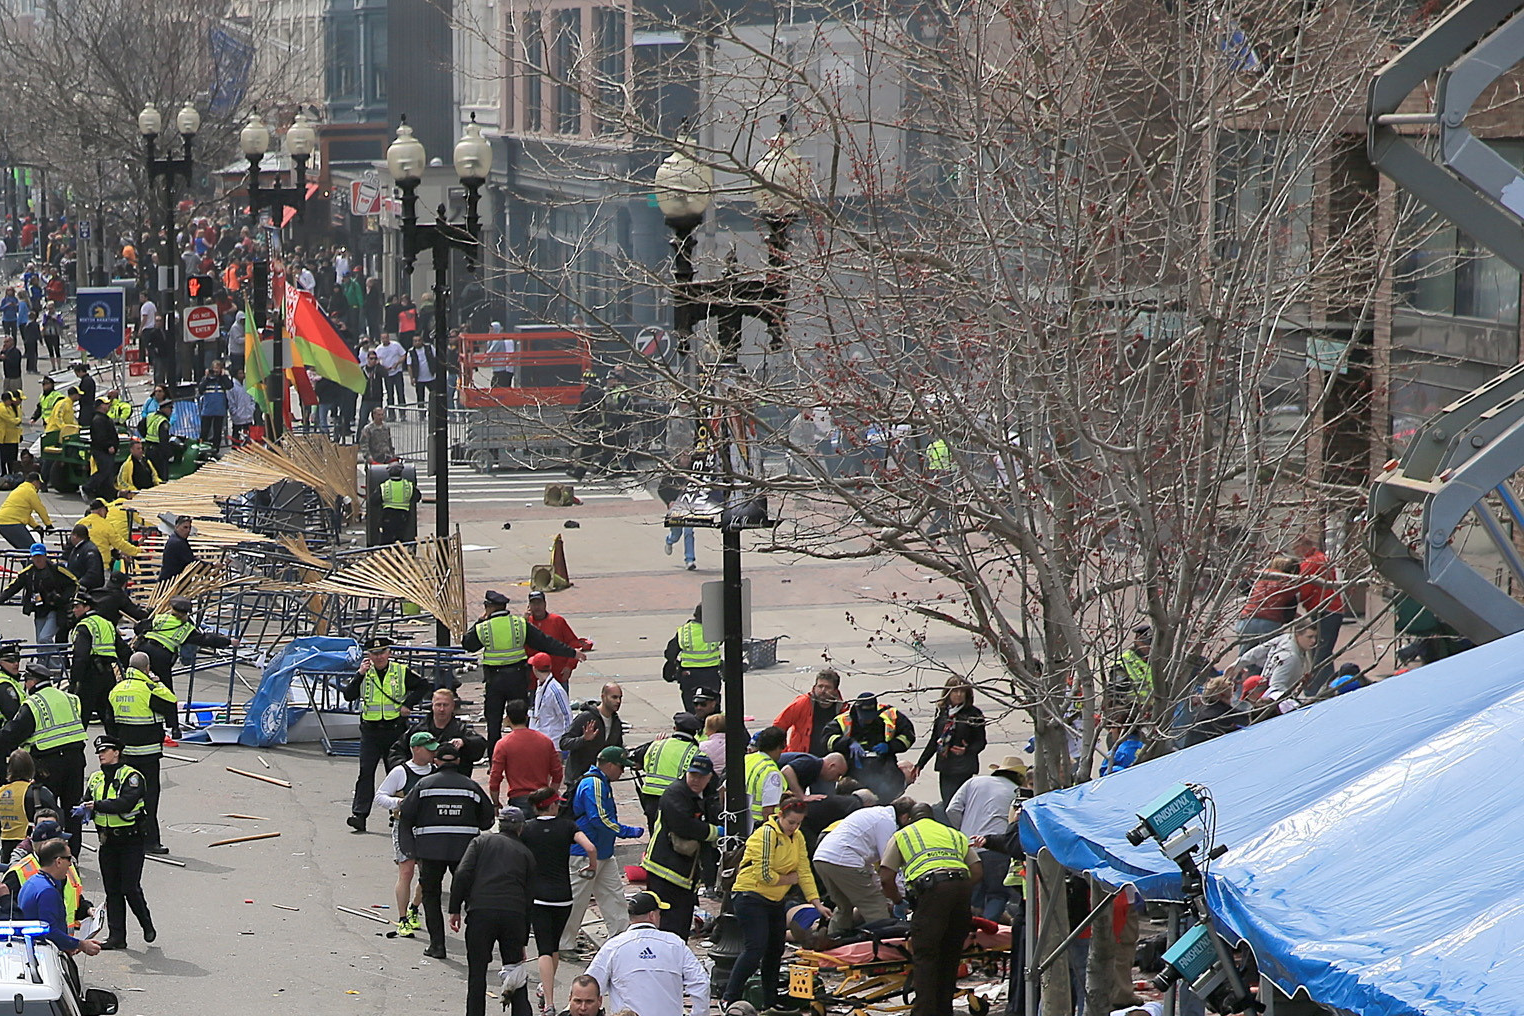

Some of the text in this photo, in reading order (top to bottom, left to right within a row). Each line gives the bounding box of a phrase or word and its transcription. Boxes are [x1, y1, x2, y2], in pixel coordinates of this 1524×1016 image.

[194, 326, 212, 334] ENTER
[1153, 796, 1190, 827] FINISHLYNX
[1180, 935, 1215, 970] FINISHLYNX
